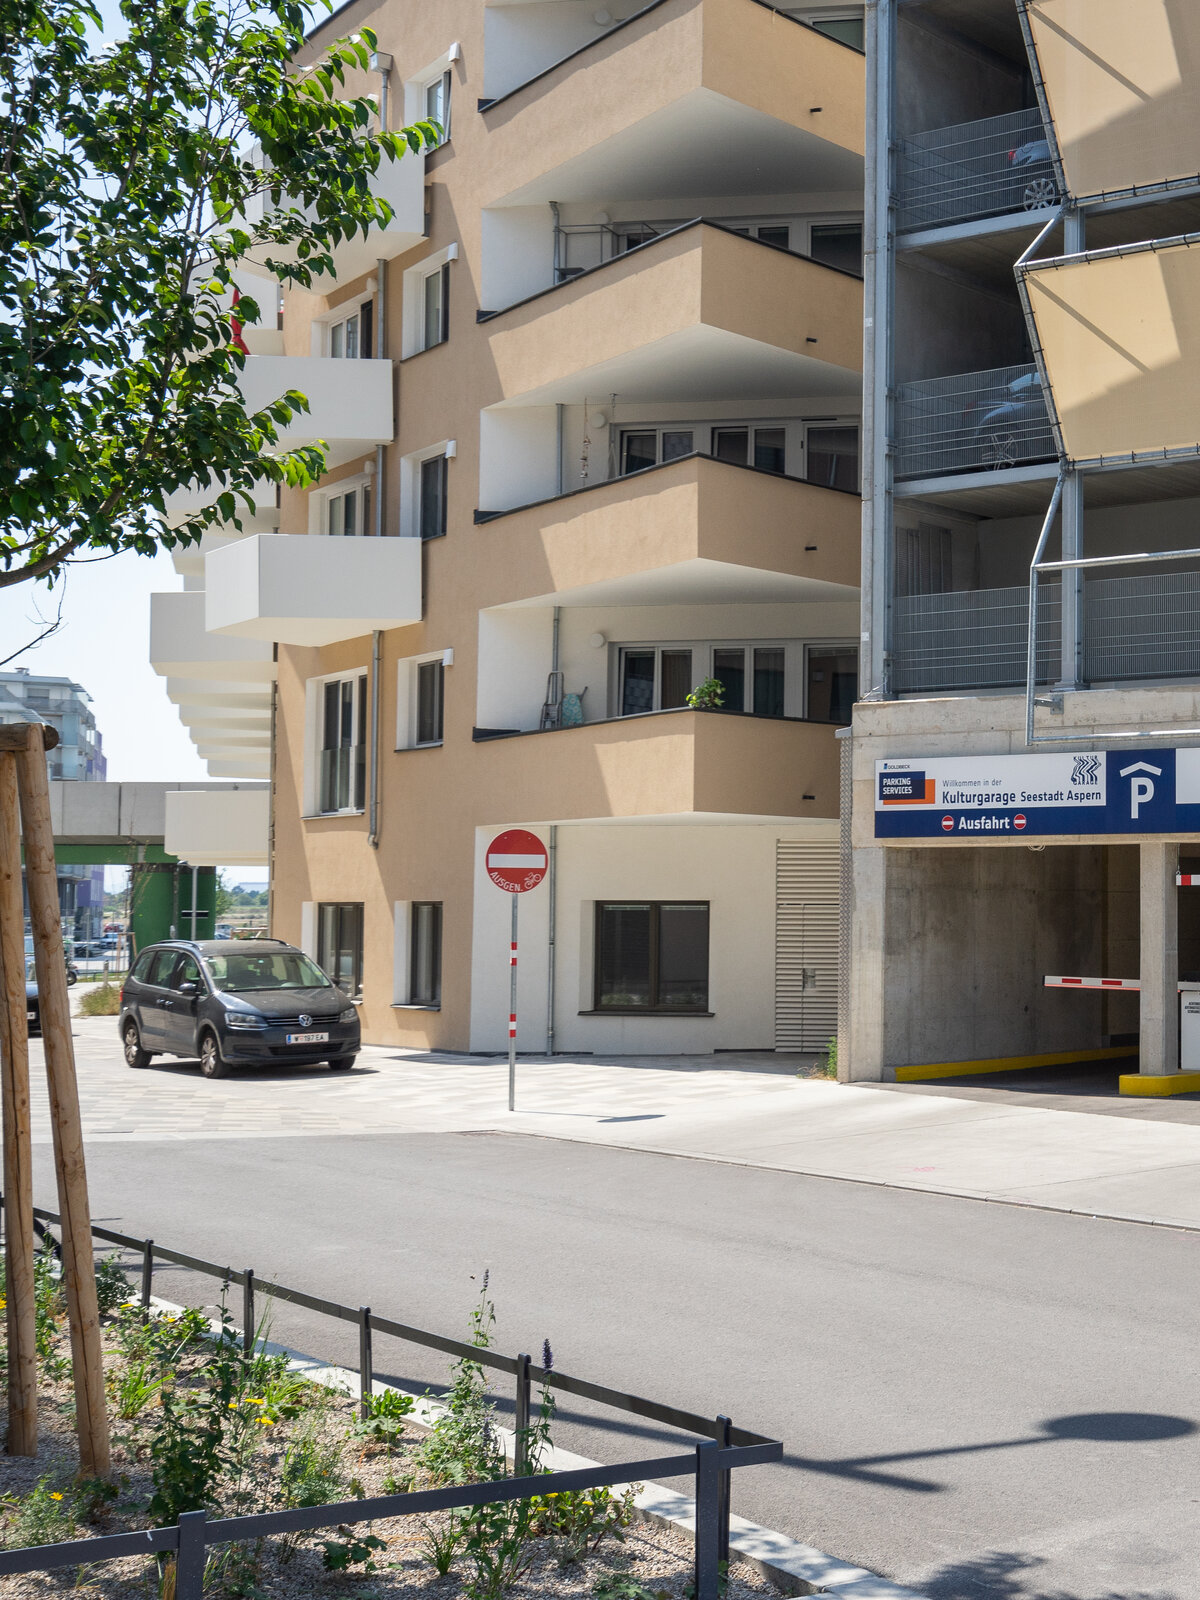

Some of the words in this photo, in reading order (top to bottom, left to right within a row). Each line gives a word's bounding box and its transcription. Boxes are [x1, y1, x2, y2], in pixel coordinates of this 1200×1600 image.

[882, 777, 911, 786] PARKING
[942, 779, 982, 788] Willkommen
[983, 778, 990, 787] in
[991, 778, 1002, 787] der
[882, 786, 912, 795] SERVICES
[942, 790, 1016, 806] Kulturgarage
[1020, 790, 1065, 802] Seestadt
[1066, 790, 1101, 803] Aspern
[1130, 777, 1155, 819] P
[958, 816, 1010, 830] Ausfahrt
[490, 871, 523, 892] AUSGEN.
